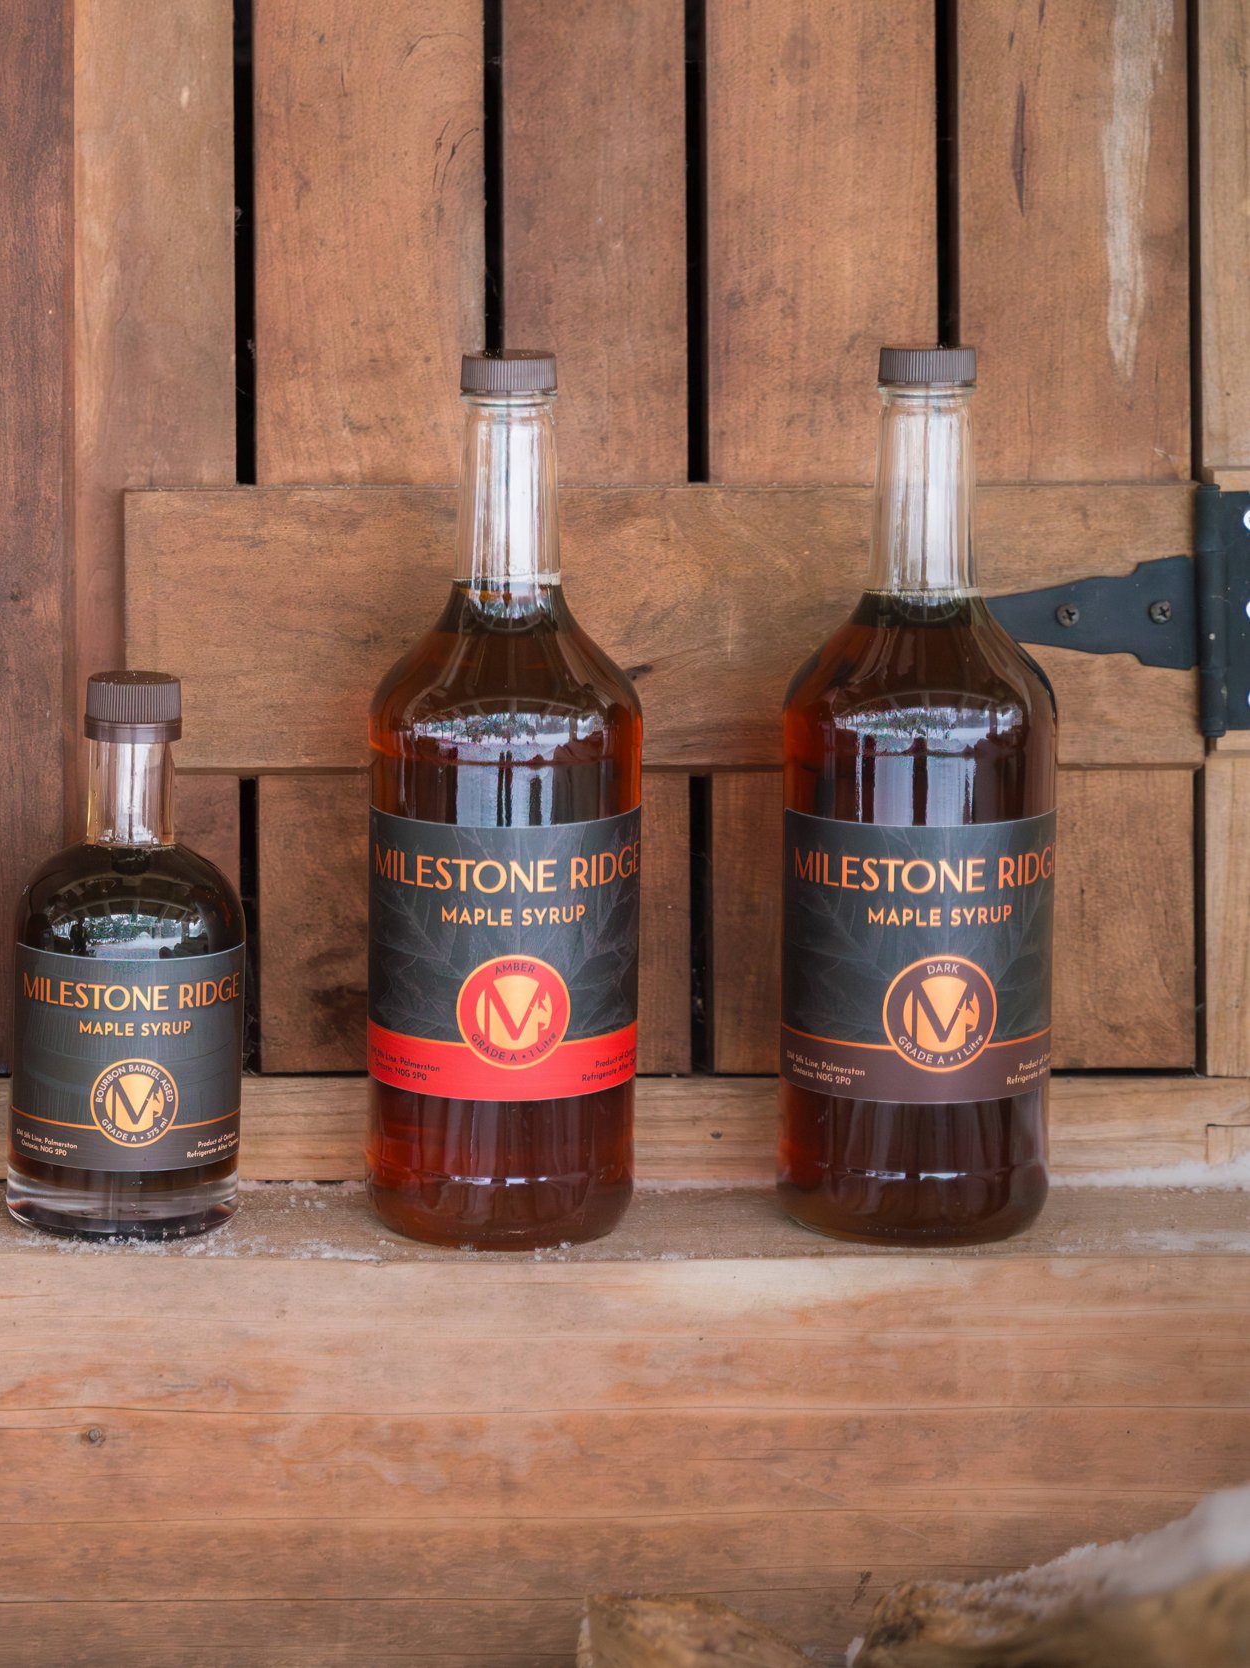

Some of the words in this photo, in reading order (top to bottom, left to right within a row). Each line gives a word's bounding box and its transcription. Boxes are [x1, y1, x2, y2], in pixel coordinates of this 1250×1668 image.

[375, 842, 557, 893] MILESTONE
[570, 840, 640, 890] RIDGE
[794, 847, 985, 894] MILESTONE
[441, 905, 512, 926] MAPLE
[521, 904, 586, 926] SYRUP
[867, 906, 941, 927] MAPLE
[950, 904, 1012, 927] SYRUP
[495, 962, 536, 975] AMBER
[926, 963, 960, 975] DARK
[23, 972, 169, 1012] MILESTONE
[178, 972, 240, 1010] RIDGE
[79, 1020, 135, 1036] MAPLE
[141, 1020, 191, 1037] SYRUP
[471, 1033, 505, 1061] GRADE
[509, 1053, 518, 1062] A
[536, 1032, 557, 1055] Litre
[898, 1035, 933, 1064] GRADE
[937, 1056, 945, 1064] A
[964, 1033, 984, 1056] Litre
[400, 1056, 440, 1072] Palmerston
[595, 1056, 618, 1068] Product
[821, 1061, 865, 1076] Palmerston
[1019, 1059, 1039, 1072] Product
[581, 1068, 617, 1082] Refrigerate
[1006, 1071, 1038, 1085] Refrigerate
[95, 1065, 126, 1103] BOURBON
[128, 1064, 160, 1080] BARREL
[159, 1079, 174, 1103] AGED
[101, 1118, 128, 1142] GRADE
[146, 1126, 160, 1140] 375
[160, 1117, 168, 1129] ml
[44, 1137, 78, 1150] Palmerston
[197, 1138, 217, 1148] Product
[186, 1148, 217, 1158] Refrigerate
